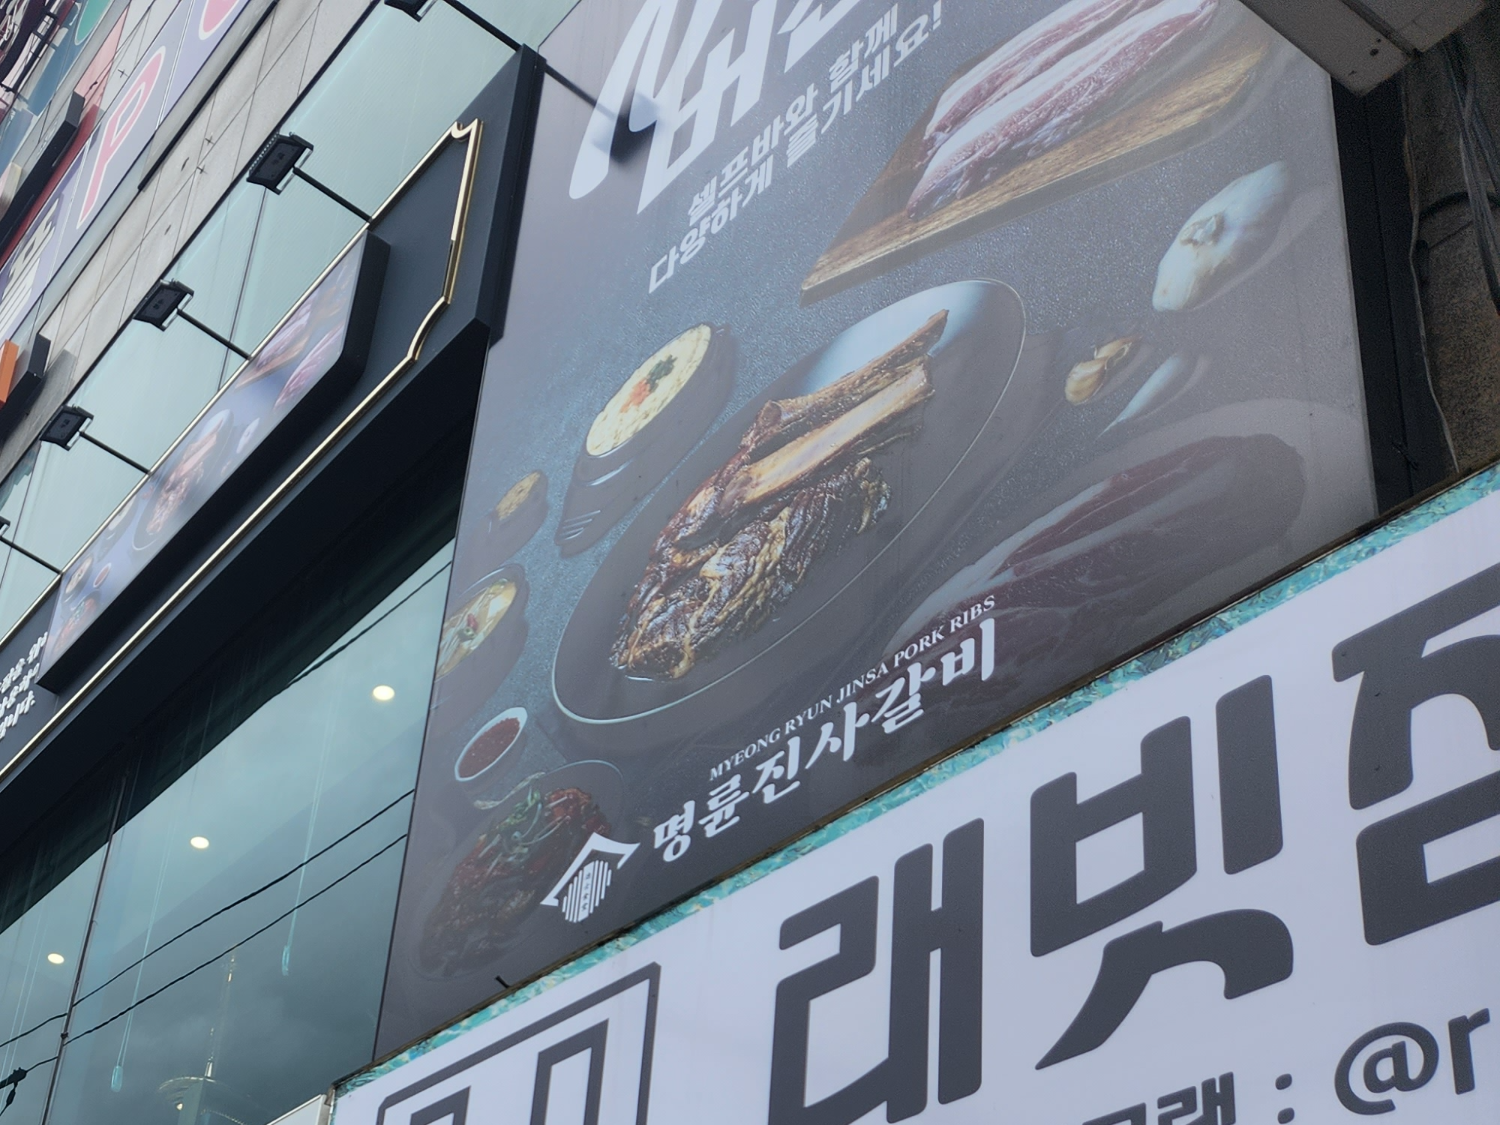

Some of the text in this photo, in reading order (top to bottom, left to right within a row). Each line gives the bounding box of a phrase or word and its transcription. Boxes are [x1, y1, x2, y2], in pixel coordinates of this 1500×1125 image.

[649, 158, 774, 294] 다양하게
[786, 1, 943, 168] 즐기세요!
[688, 83, 819, 226] 셀프바와
[829, 3, 899, 85] 함께
[651, 618, 997, 863] 명륜진사갈비
[708, 595, 997, 781] MYEONG RYUN JINSA PORK RIBS
[1333, 1006, 1492, 1117] @r
